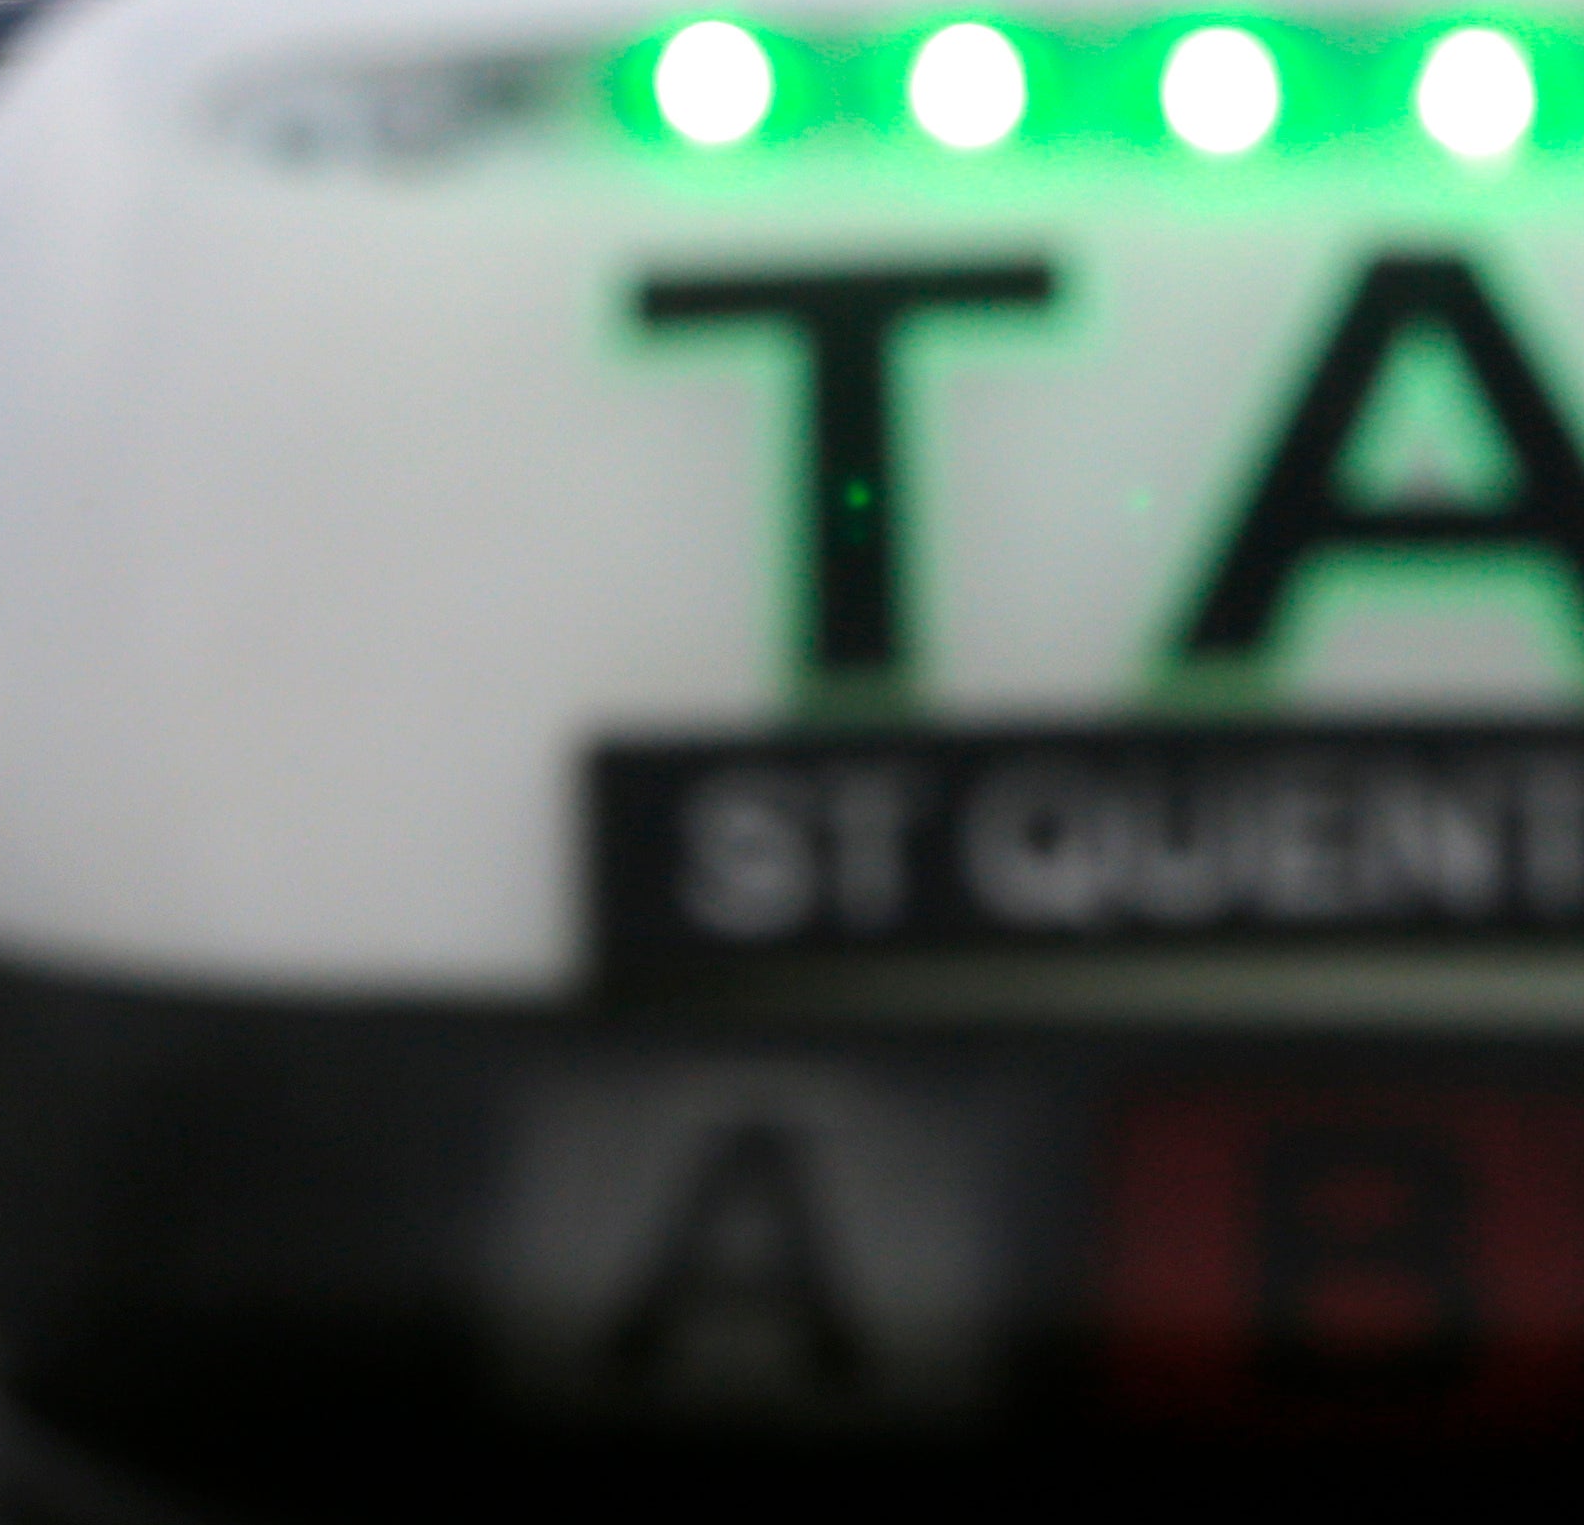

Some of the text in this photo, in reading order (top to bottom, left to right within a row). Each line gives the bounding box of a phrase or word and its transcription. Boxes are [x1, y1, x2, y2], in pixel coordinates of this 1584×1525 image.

[680, 760, 906, 939] ST
[602, 1116, 872, 1406] A
[1242, 1121, 1478, 1401] B
